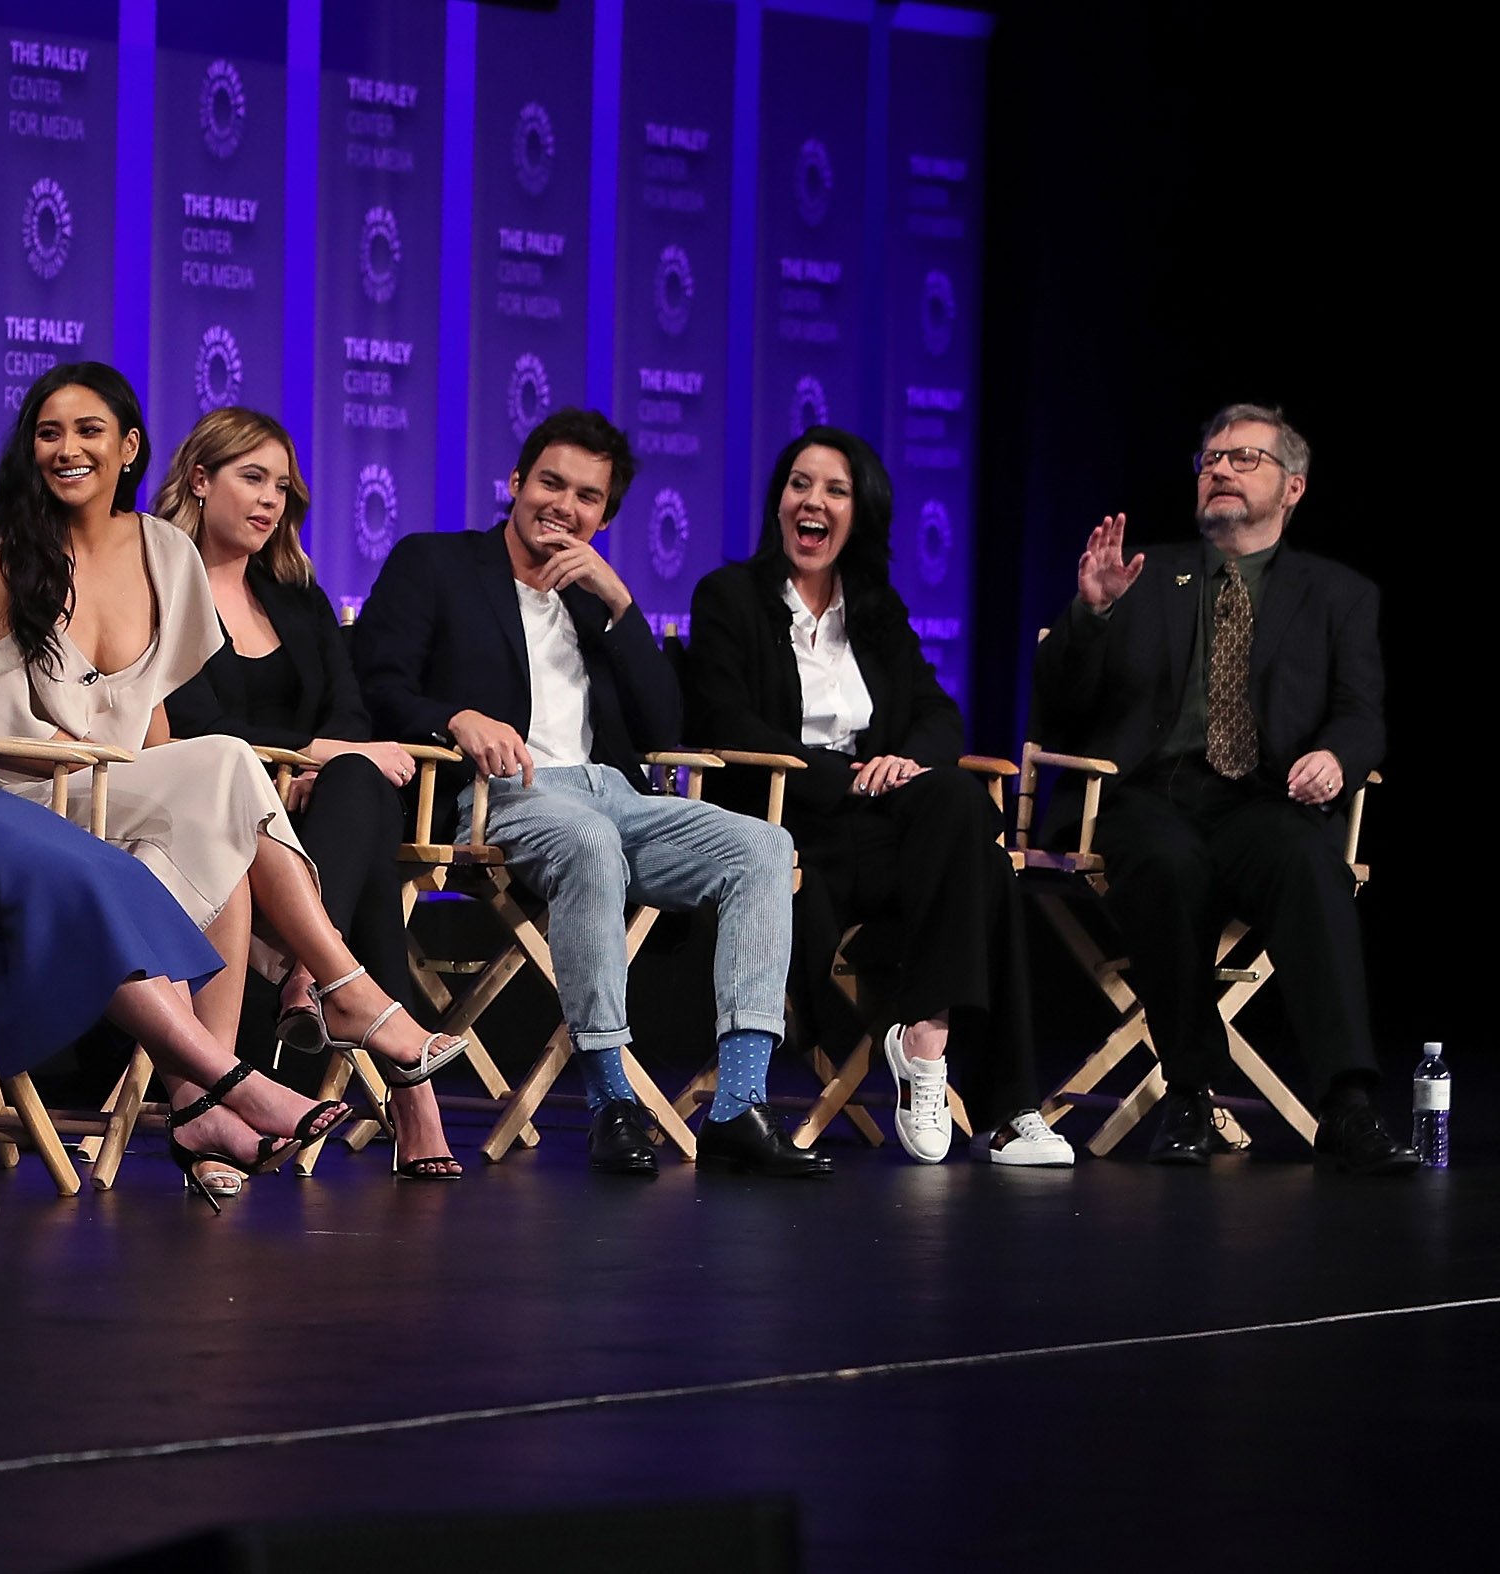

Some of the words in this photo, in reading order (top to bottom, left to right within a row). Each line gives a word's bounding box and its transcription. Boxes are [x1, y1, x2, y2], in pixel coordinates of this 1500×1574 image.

[9, 40, 40, 68] THE
[42, 45, 89, 72] PALEY
[182, 192, 212, 219] THE
[212, 196, 259, 224] PALEY
[5, 315, 37, 342] THE
[39, 318, 84, 345] PALEY
[343, 336, 369, 362] THE
[369, 339, 414, 366] PALEY
[4, 386, 30, 412] FO
